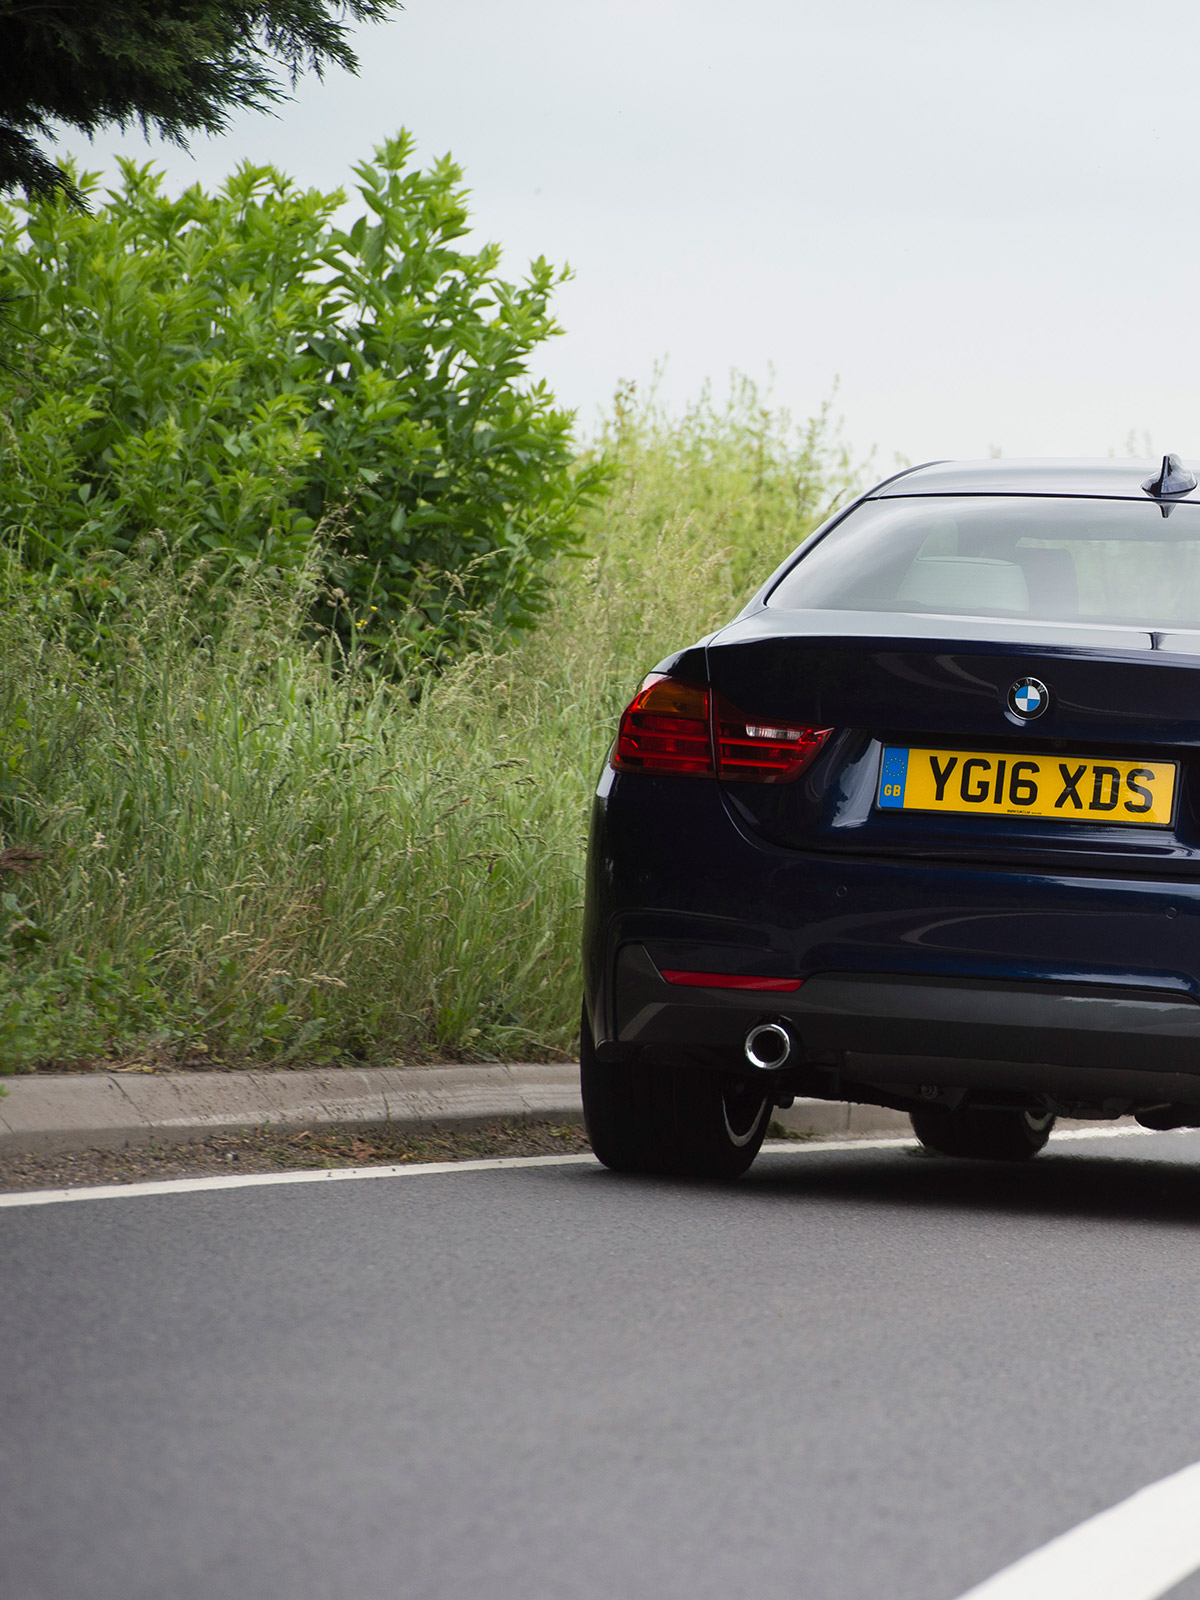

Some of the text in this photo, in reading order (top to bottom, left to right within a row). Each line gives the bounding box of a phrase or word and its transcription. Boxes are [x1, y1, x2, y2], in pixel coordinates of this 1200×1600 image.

[1012, 678, 1046, 693] BMW
[884, 785, 901, 797] GB
[929, 756, 1156, 813] YG16 XDS
